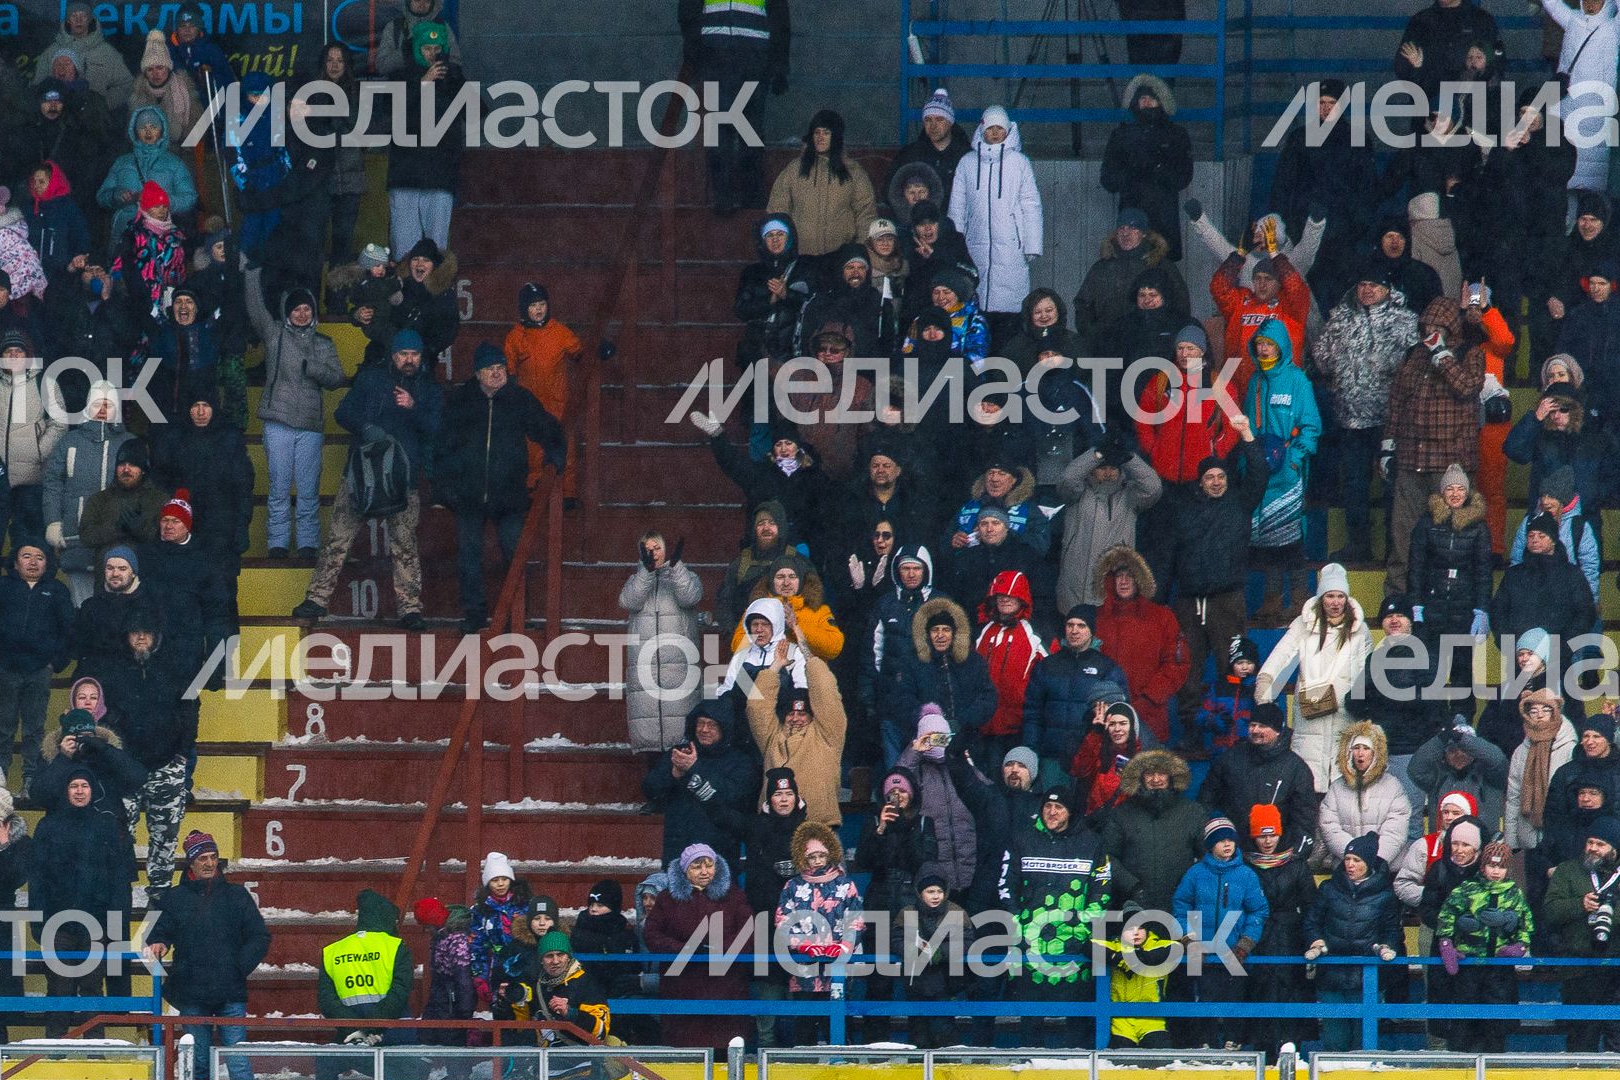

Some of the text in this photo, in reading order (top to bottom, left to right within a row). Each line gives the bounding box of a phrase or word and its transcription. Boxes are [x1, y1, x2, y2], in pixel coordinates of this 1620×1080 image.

[347, 579, 378, 618] 10
[331, 643, 352, 679] 9
[305, 702, 326, 736] 8
[286, 764, 307, 801] 7
[266, 820, 285, 857] 6
[334, 951, 381, 965] STEWARD
[345, 974, 374, 989] 600
